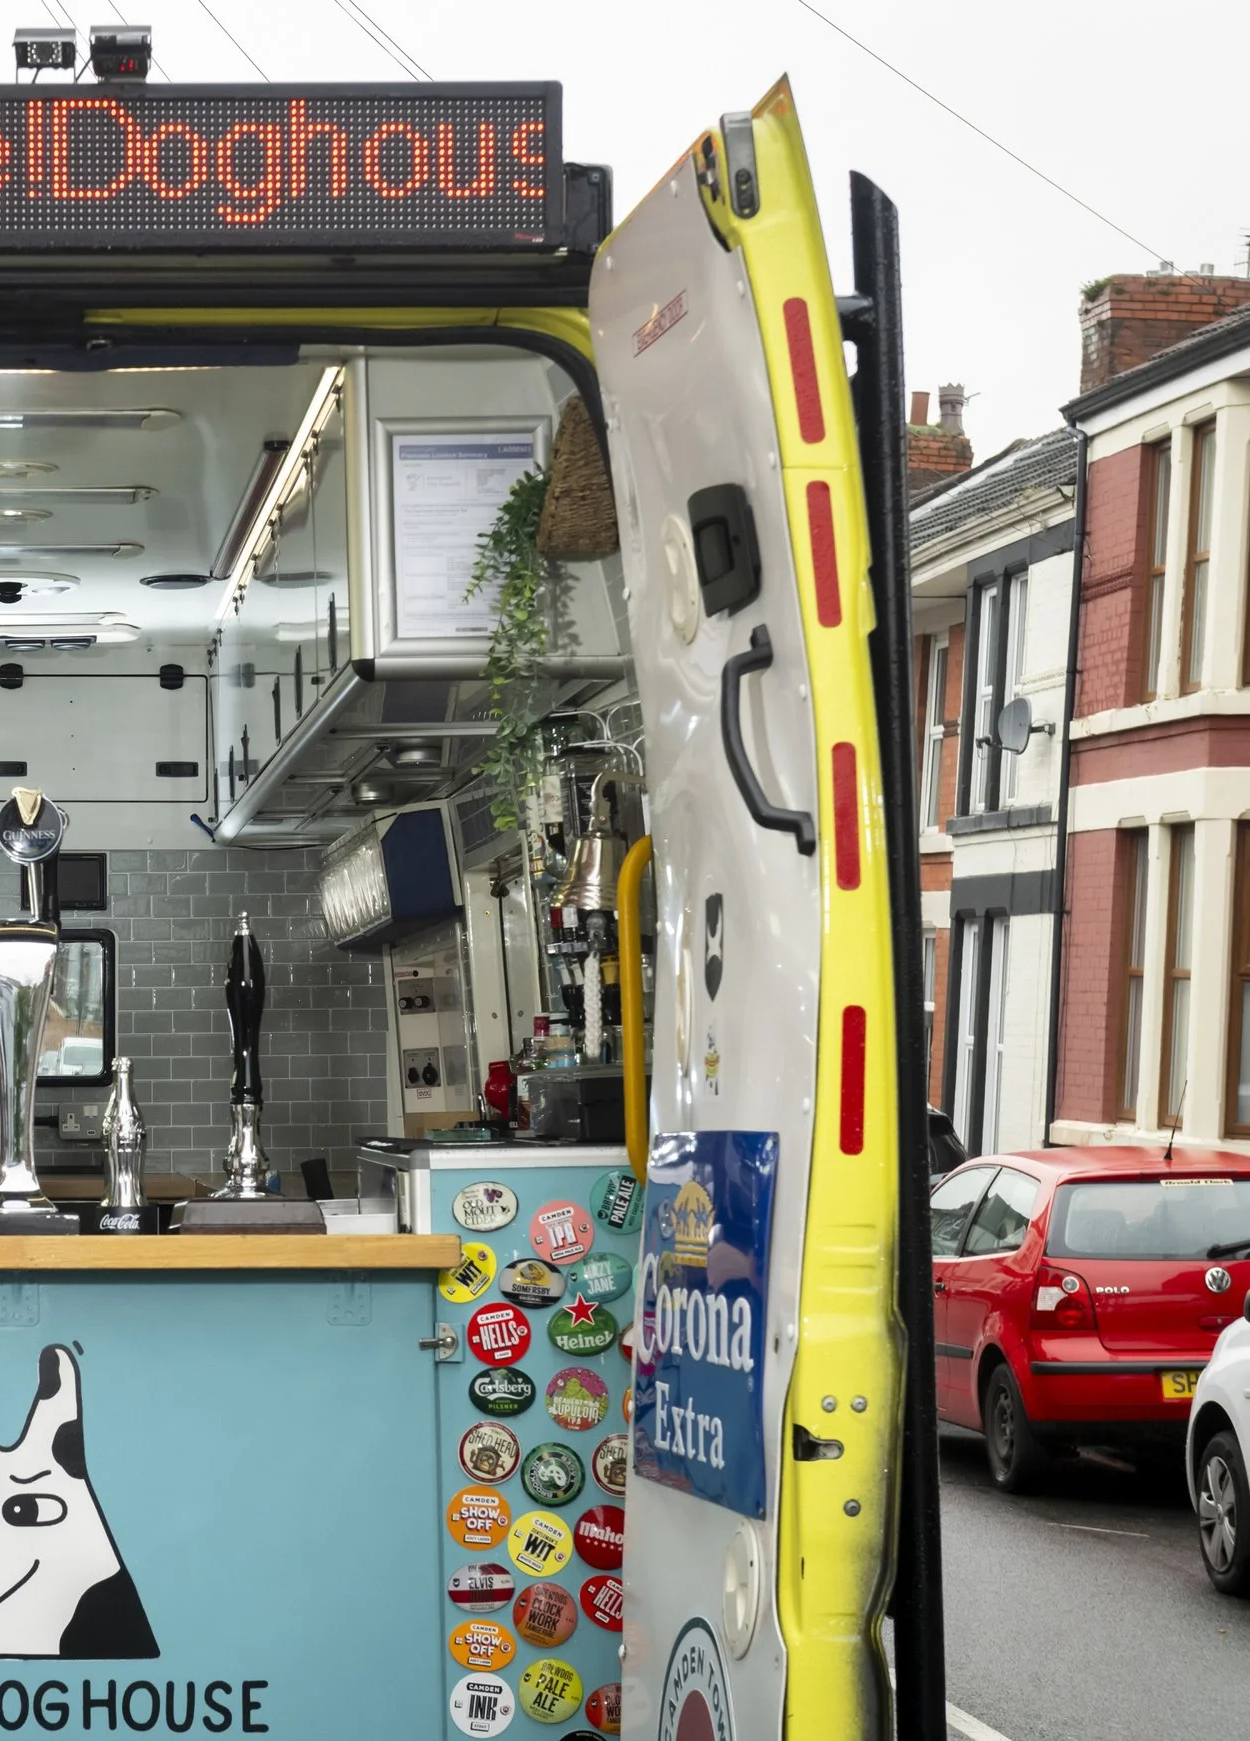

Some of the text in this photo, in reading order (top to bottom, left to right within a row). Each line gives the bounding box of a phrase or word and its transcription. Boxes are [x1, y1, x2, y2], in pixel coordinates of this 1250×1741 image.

[2, 829, 56, 842] GUINNESS
[462, 1199, 484, 1210] OLD
[610, 1179, 635, 1224] PALE ALE
[541, 1209, 572, 1222] CAMDEN
[548, 1222, 578, 1249] IPA
[455, 1259, 482, 1287] WIT
[583, 1261, 612, 1279] HAZY
[512, 1283, 551, 1296] SOMERSBY
[587, 1276, 617, 1294] JANE
[1096, 1286, 1130, 1294] POLO
[479, 1312, 511, 1322] CAMDEN
[637, 1252, 754, 1373] Corona
[479, 1320, 520, 1351] HELLS
[474, 1377, 532, 1398] Carlsberg
[567, 1416, 581, 1425] IPA
[654, 1380, 725, 1470] Extra
[468, 1429, 494, 1446] SHED
[494, 1437, 517, 1458] HEAD
[600, 1444, 624, 1460] SHED
[465, 1496, 496, 1504] CAMDEN
[460, 1506, 500, 1520] SHOW
[466, 1517, 493, 1531] OFF
[534, 1519, 563, 1538] CAMDEN
[523, 1533, 556, 1561] WIT
[469, 1576, 494, 1590] ELVIS
[531, 1598, 565, 1618] CLOCK
[472, 1625, 497, 1633] CAMDEN
[528, 1609, 560, 1631] WORK
[465, 1633, 502, 1646] SHOW
[470, 1643, 495, 1656] OFF
[541, 1662, 574, 1682] BREWDOG
[468, 1683, 500, 1693] CAMDEN
[535, 1673, 570, 1699] PALE
[468, 1694, 498, 1721] INK
[532, 1691, 560, 1713] ALE
[708, 1661, 727, 1741] TOW
